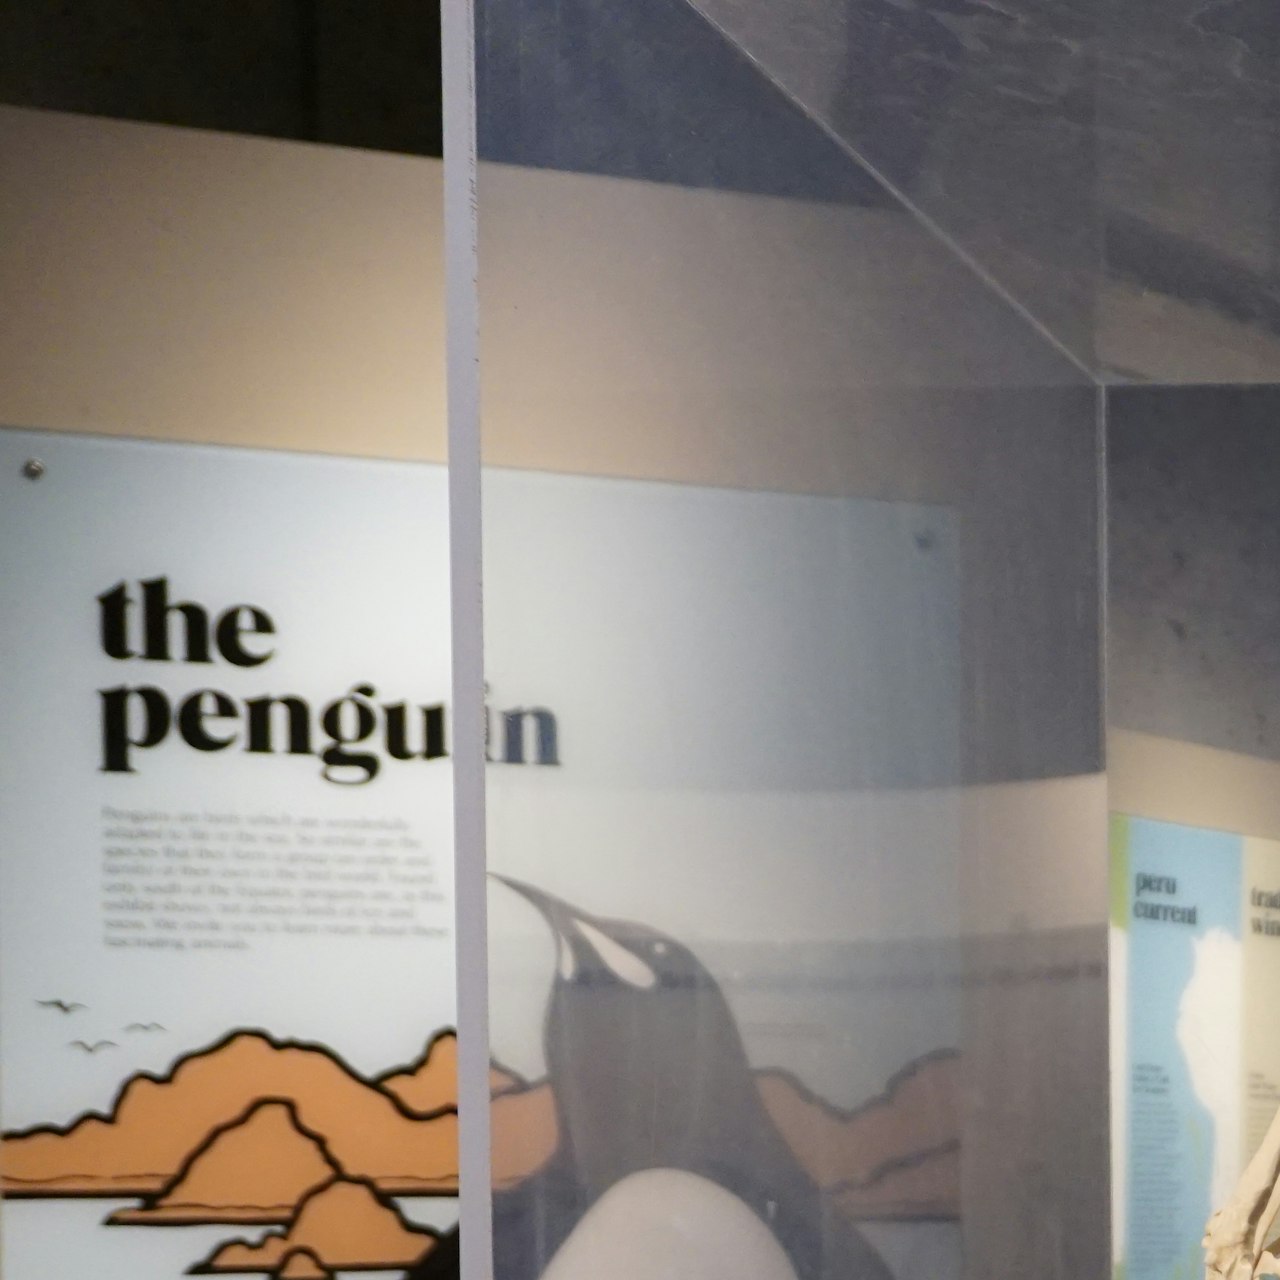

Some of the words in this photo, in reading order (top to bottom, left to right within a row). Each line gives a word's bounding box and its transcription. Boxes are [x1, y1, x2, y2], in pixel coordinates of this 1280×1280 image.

[97, 576, 277, 668] the
[97, 682, 562, 786] pengun
[1135, 872, 1178, 897] peru
